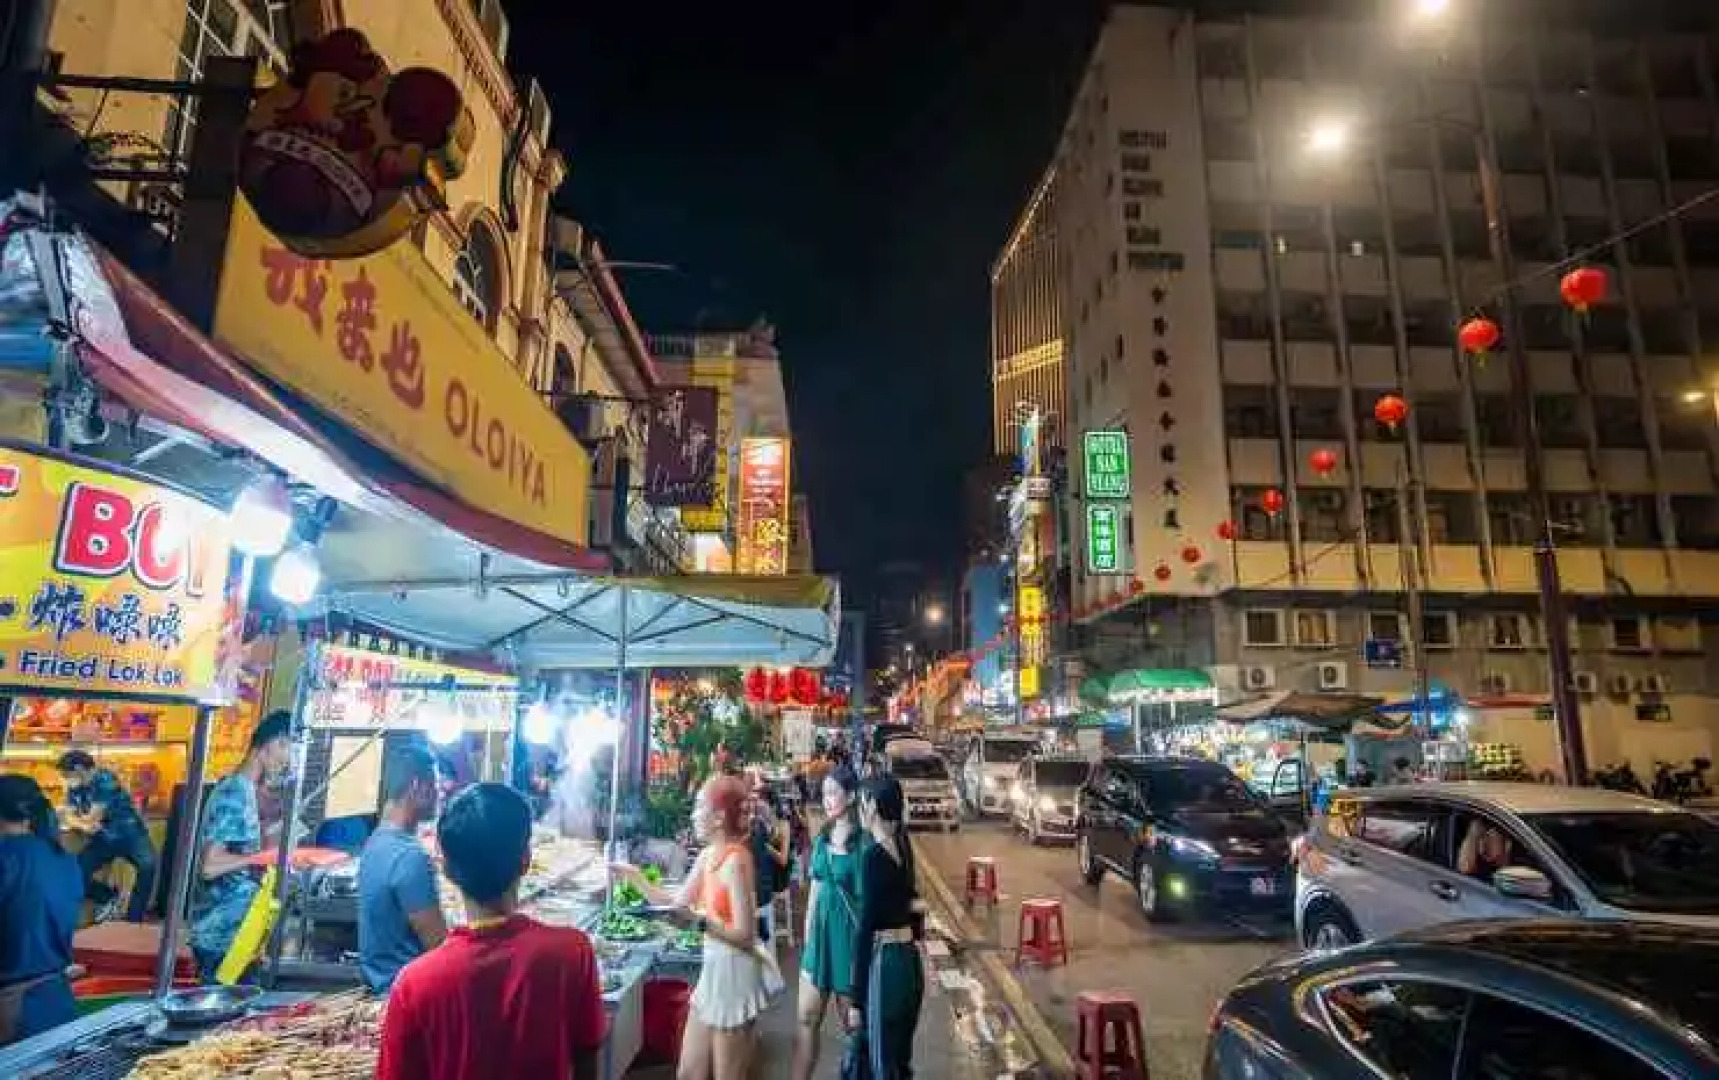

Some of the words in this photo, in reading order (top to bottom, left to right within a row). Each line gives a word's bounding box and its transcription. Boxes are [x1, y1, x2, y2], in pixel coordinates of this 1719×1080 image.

[445, 376, 546, 506] OLOIYA
[19, 650, 97, 680] Fried
[108, 656, 147, 684] Lok
